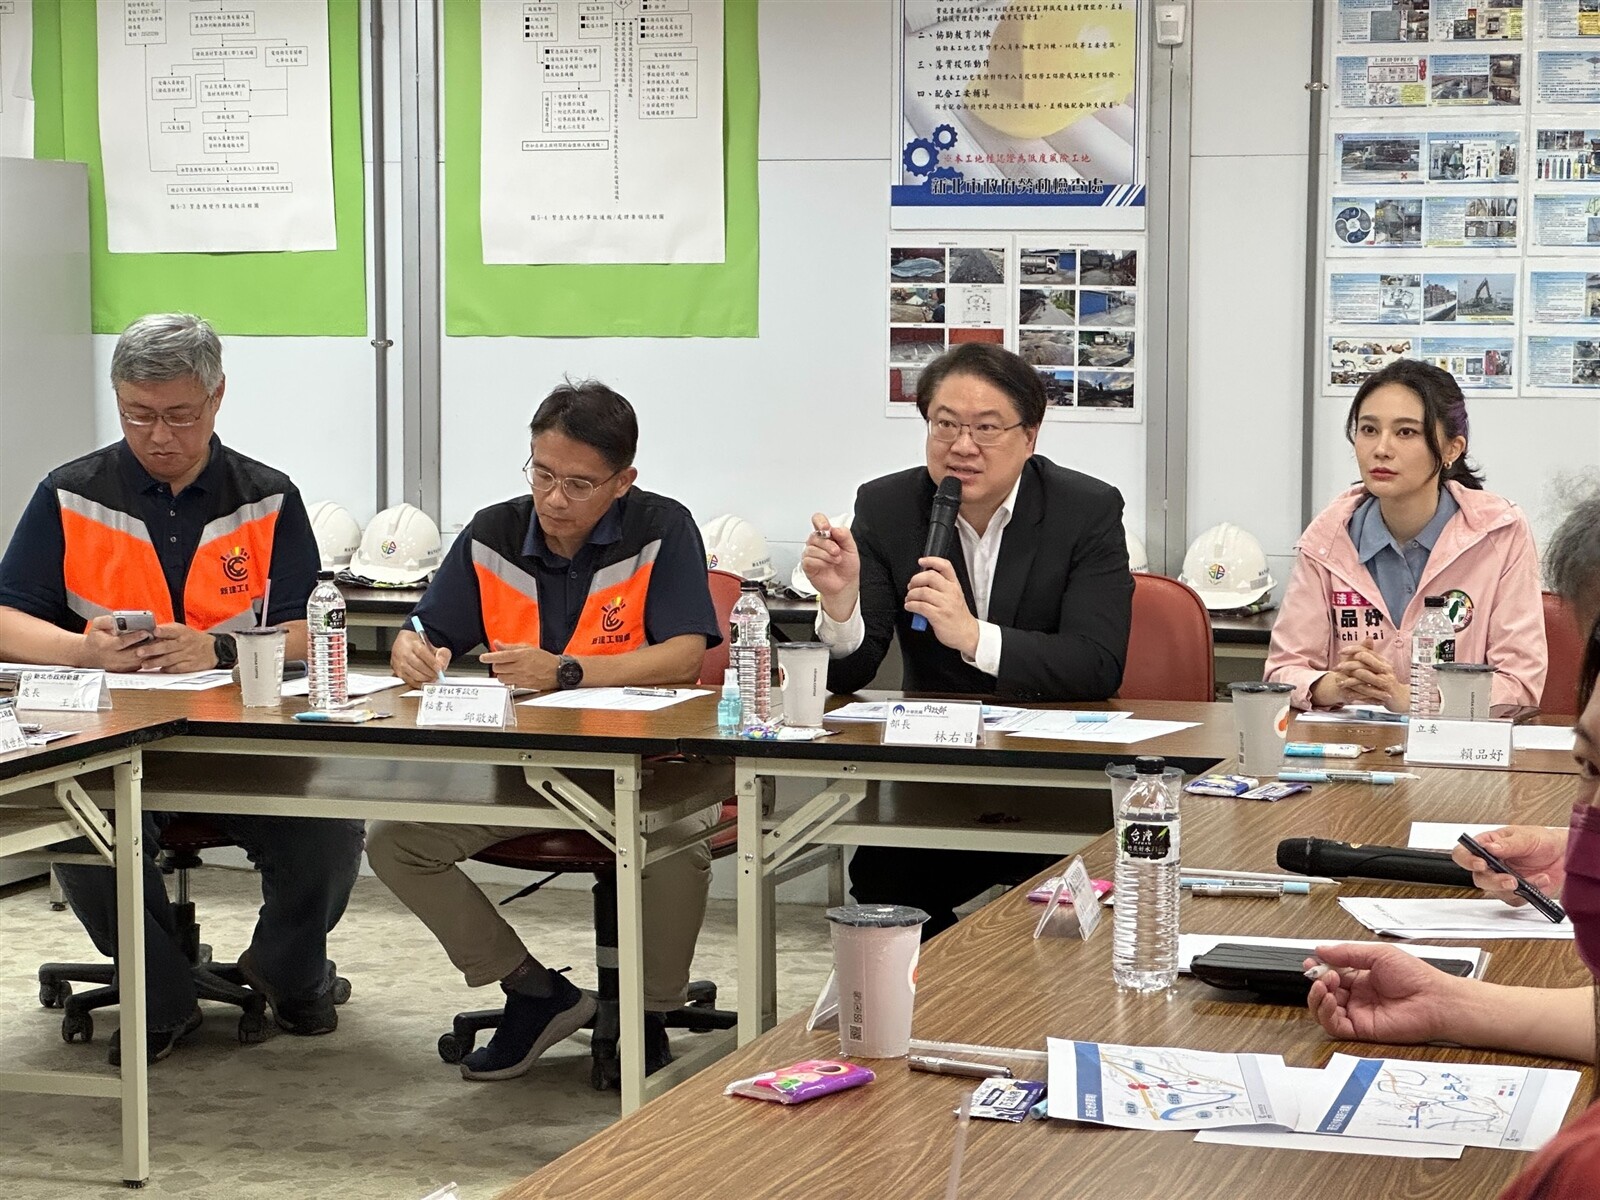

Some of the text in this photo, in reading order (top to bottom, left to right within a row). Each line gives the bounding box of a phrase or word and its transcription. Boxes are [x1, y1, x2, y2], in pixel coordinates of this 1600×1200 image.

[918, 30, 992, 40] 二、協助教育訓練
[917, 59, 991, 70] 三、落實投保動作
[917, 88, 990, 99] 四、配合工安輔導
[931, 176, 1104, 196] 新北市政府勞動檢查處
[1332, 593, 1371, 605] 法委
[1332, 608, 1384, 628] 品妤
[22, 687, 40, 698] 處長
[438, 687, 479, 696] 新北市政府
[424, 700, 454, 712] 秘書長
[924, 704, 948, 715] 內政部
[464, 712, 499, 725] 邱敬斌
[890, 718, 911, 730] 部長
[1416, 724, 1439, 735] 立委
[934, 730, 974, 744] 林右昌
[1459, 748, 1504, 762] 賴品妤
[1130, 828, 1153, 842] 台灣
